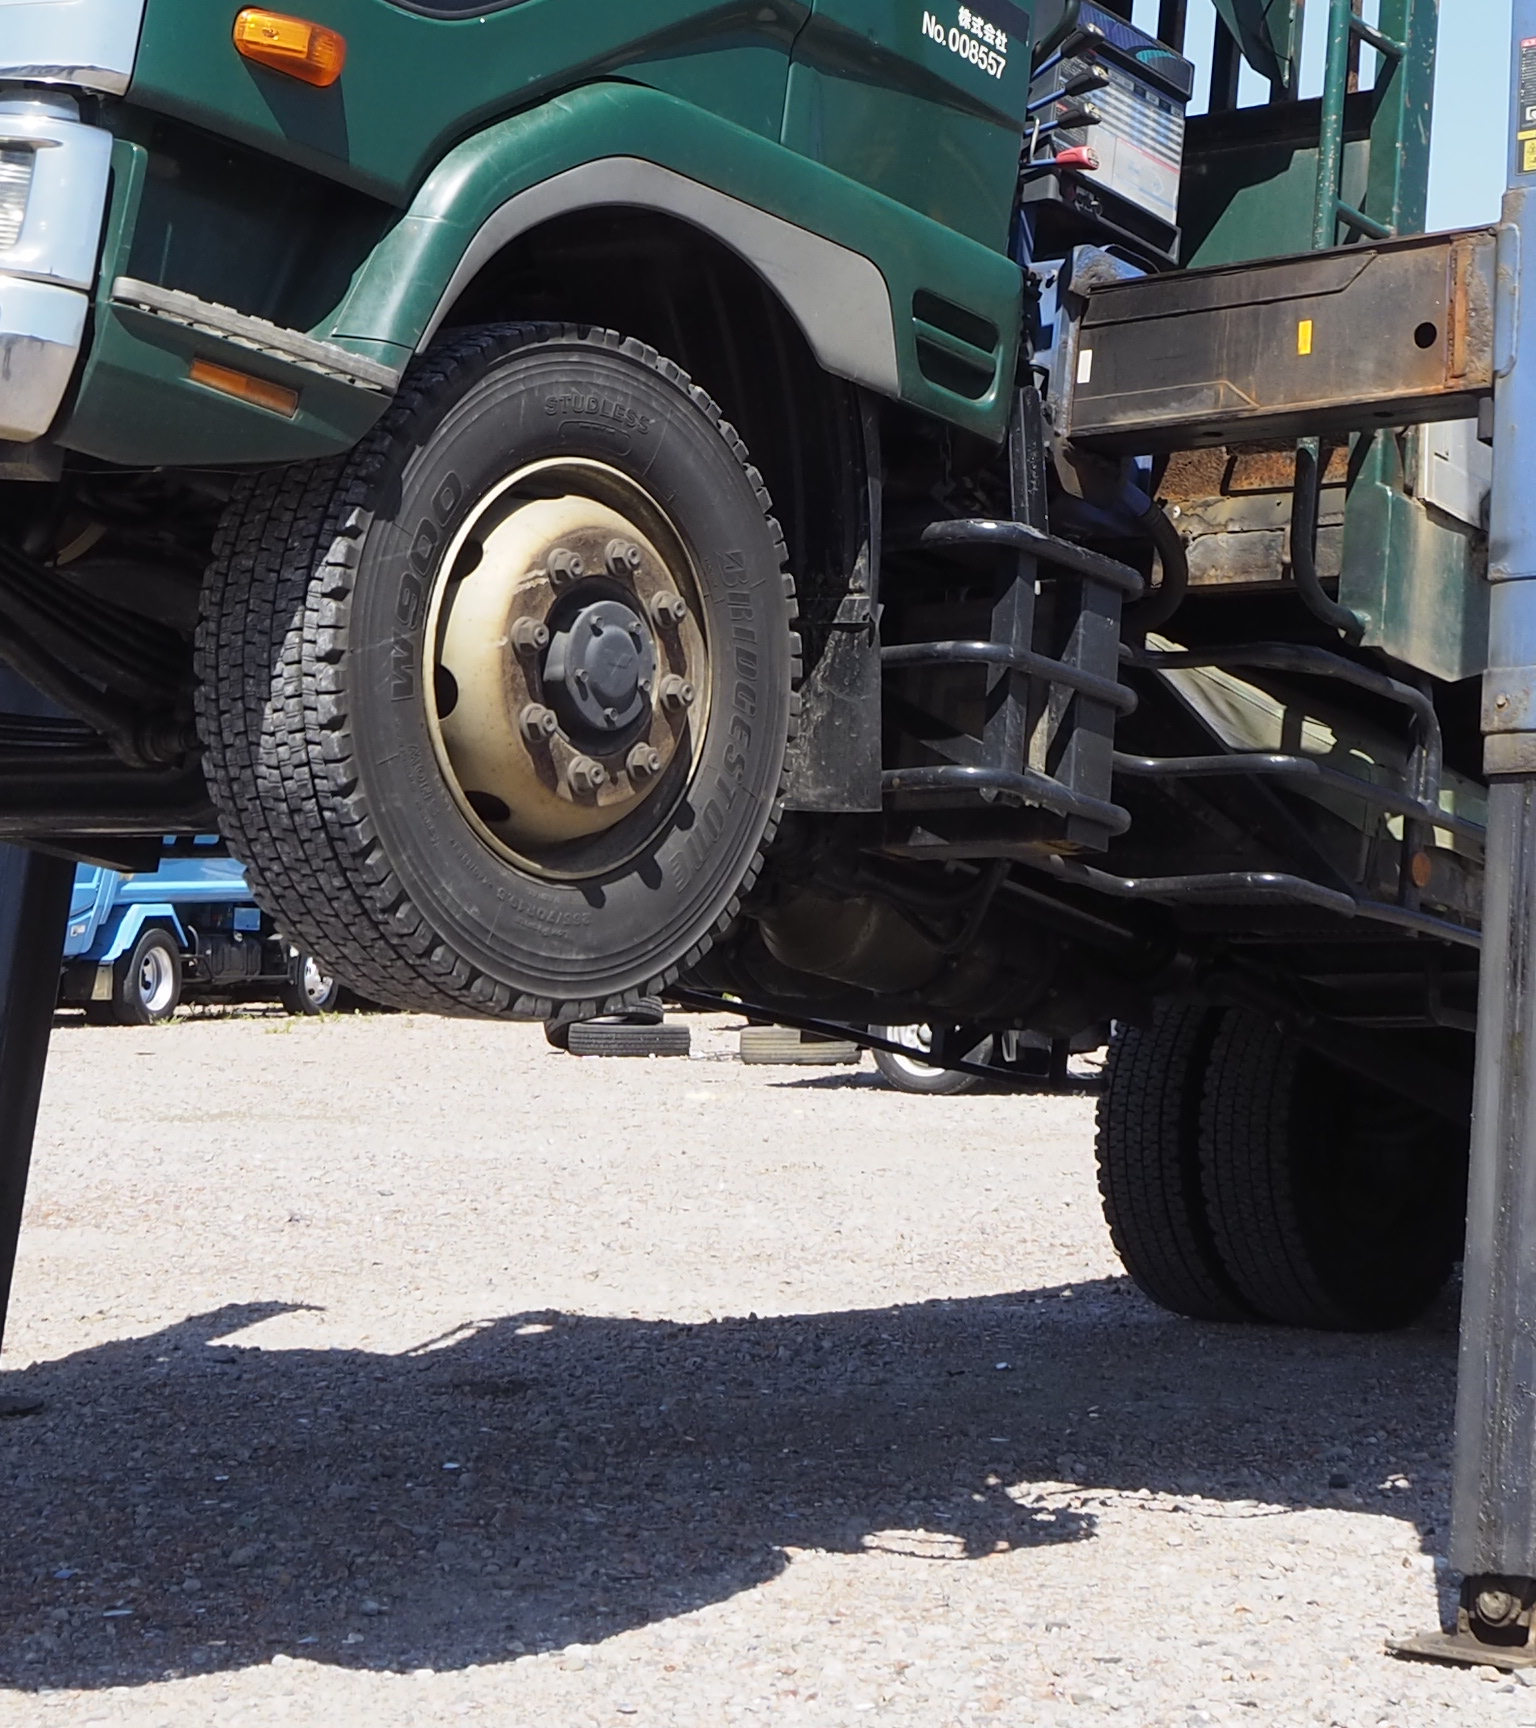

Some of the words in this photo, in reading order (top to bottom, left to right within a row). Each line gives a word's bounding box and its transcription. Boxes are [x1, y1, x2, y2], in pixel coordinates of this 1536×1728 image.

[958, 6, 1008, 53] 株式会社
[545, 393, 651, 435] STUDLESS
[390, 470, 463, 702] W900
[668, 550, 758, 894] BRIDGESTONE
